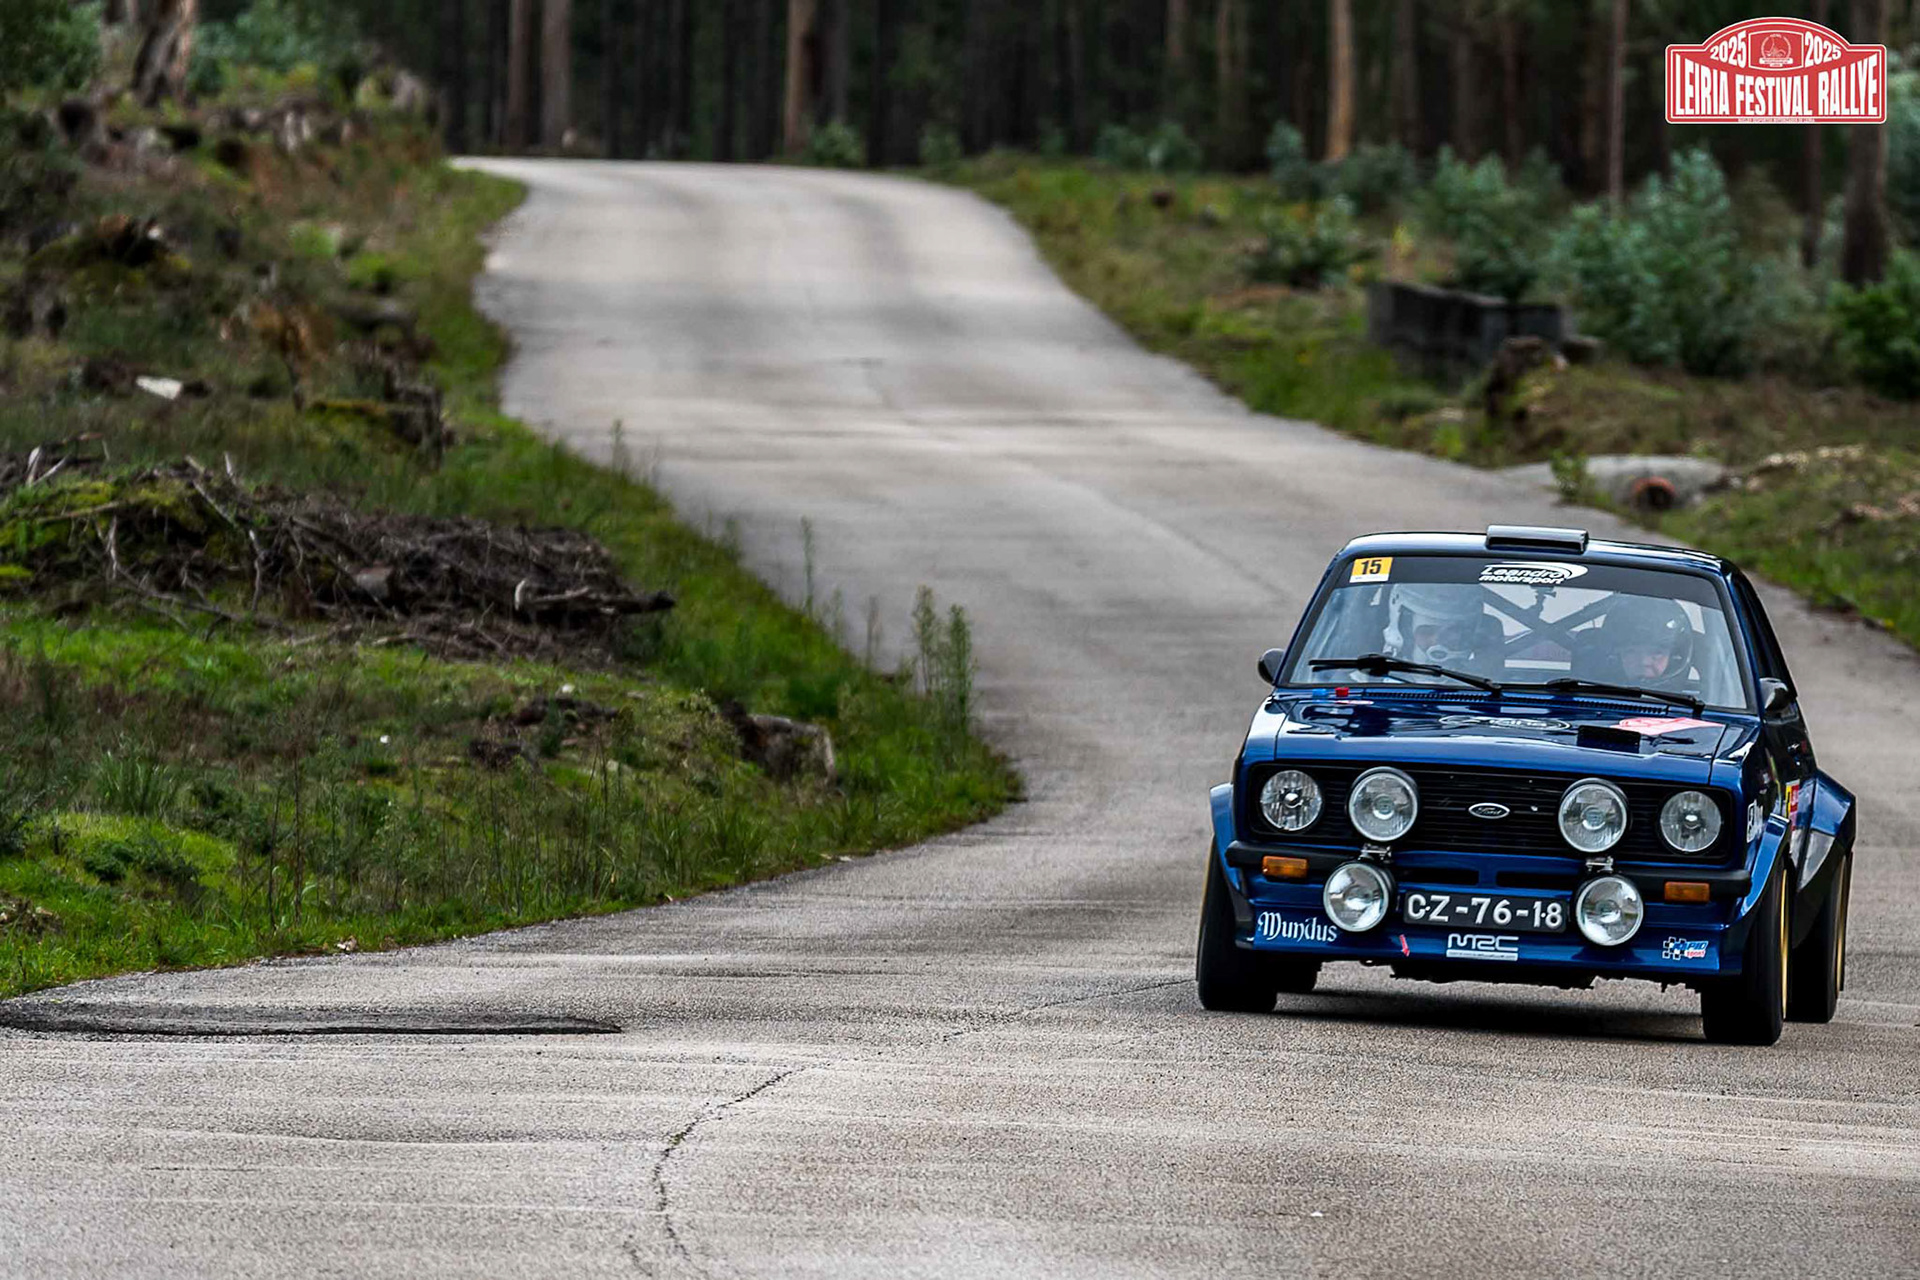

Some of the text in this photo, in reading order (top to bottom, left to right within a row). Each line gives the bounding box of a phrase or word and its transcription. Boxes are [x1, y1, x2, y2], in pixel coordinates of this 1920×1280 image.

[1361, 559, 1382, 575] 15
[1481, 566, 1561, 579] Leandro
[1479, 575, 1564, 585] motorsport
[1257, 911, 1338, 942] Mundus
